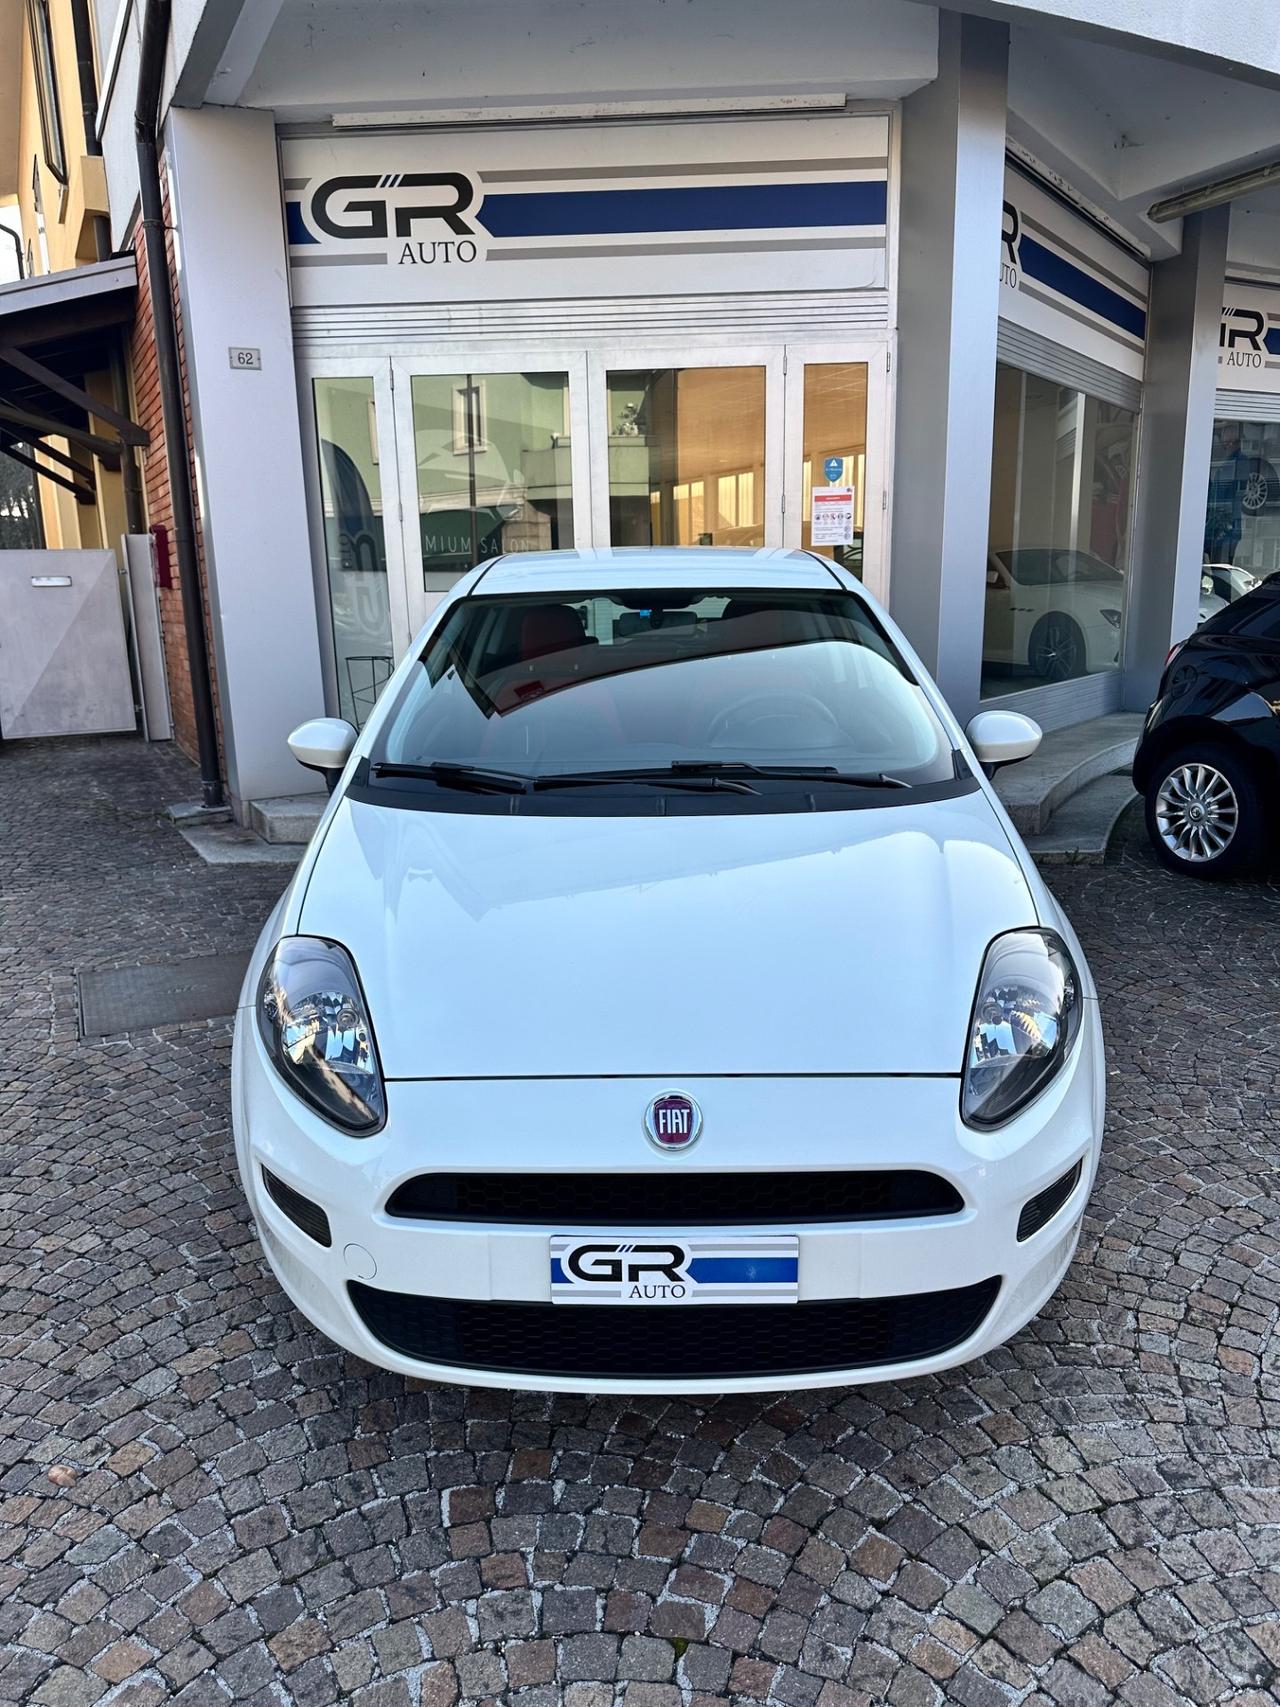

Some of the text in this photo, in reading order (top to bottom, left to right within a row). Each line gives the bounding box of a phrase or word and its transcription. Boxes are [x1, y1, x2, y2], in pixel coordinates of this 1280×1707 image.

[311, 171, 475, 238] GR
[1002, 200, 1018, 265] R
[398, 240, 477, 265] AUTO
[1000, 263, 1017, 288] UTO
[1220, 307, 1264, 351] R
[237, 352, 254, 365] 62
[1227, 352, 1263, 368] AUTO
[658, 1108, 690, 1134] FIAT
[568, 1244, 686, 1283] GR
[629, 1285, 686, 1299] AUTO
